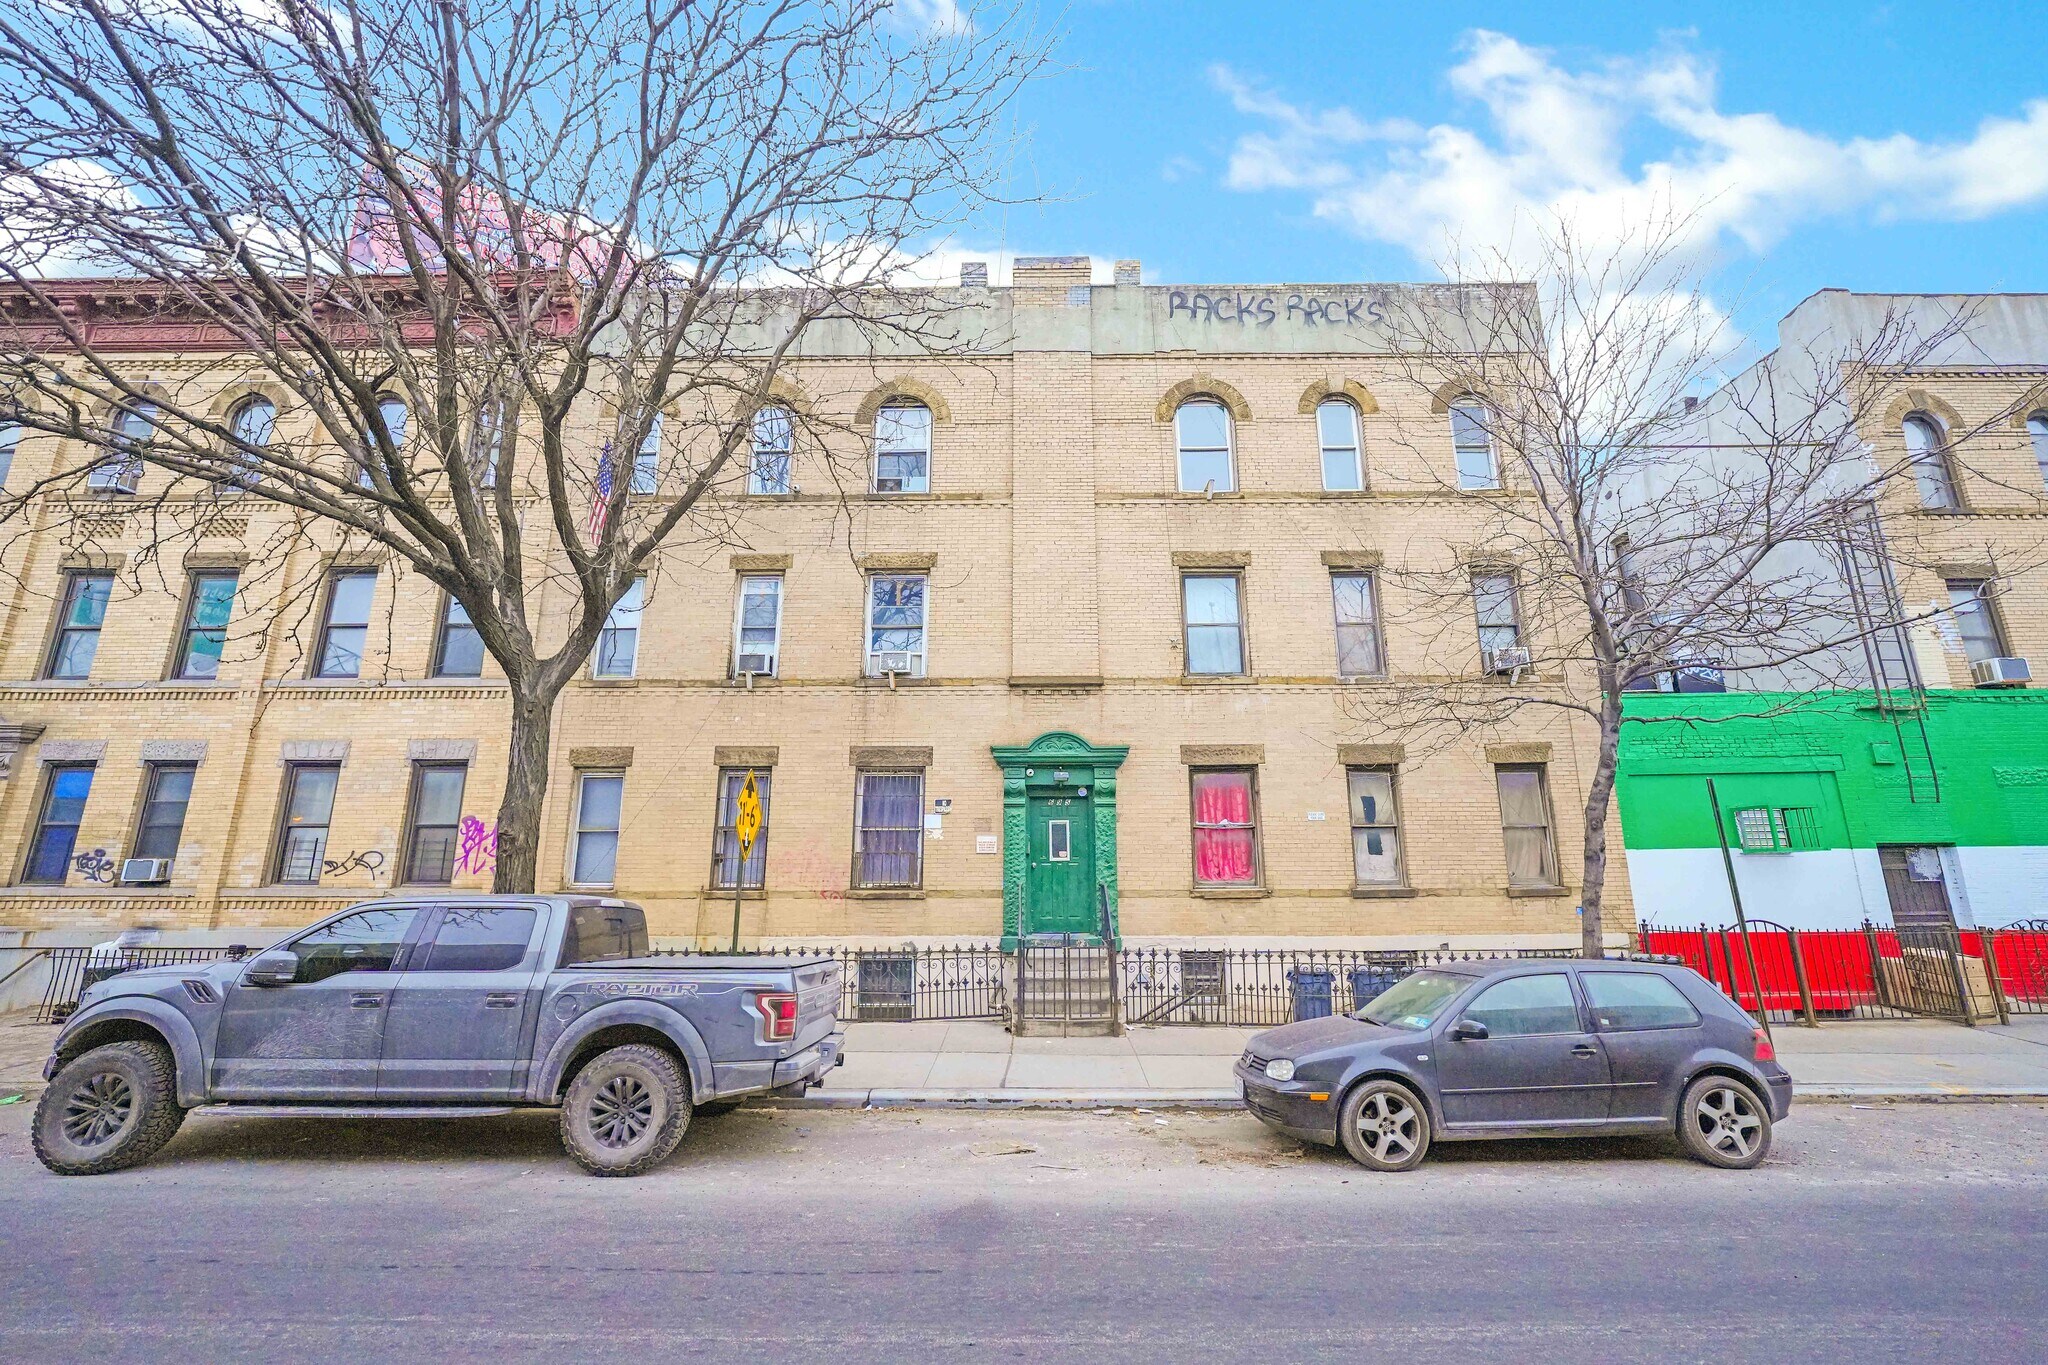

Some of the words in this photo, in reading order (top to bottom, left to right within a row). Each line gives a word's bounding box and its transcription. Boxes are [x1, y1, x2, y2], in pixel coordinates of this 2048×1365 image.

[1169, 291, 1277, 328] RACKS
[1287, 294, 1384, 328] RACKS
[586, 983, 699, 998] RAPTOR
